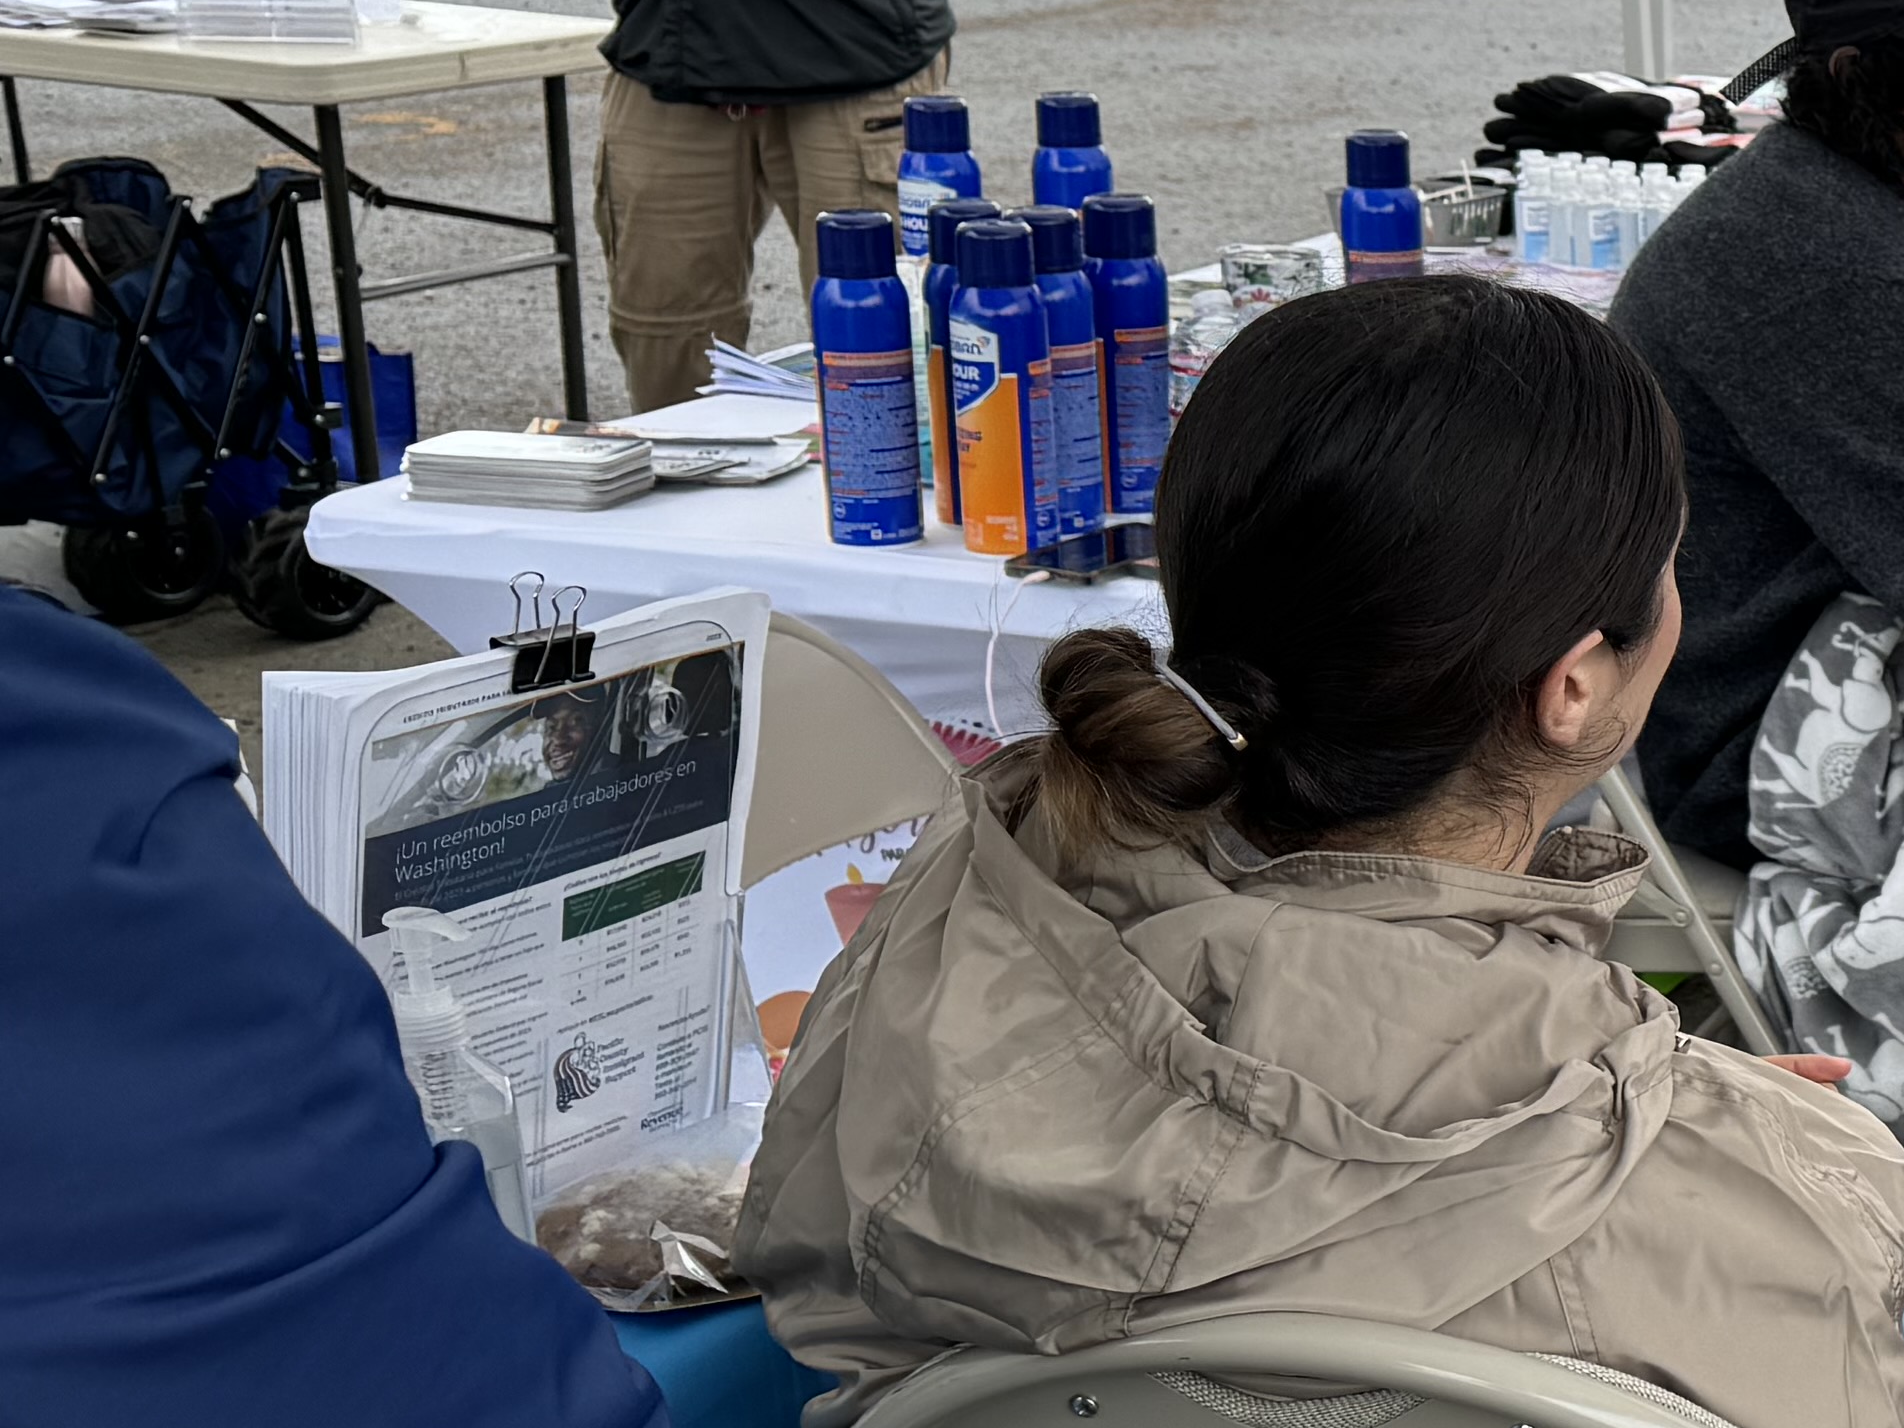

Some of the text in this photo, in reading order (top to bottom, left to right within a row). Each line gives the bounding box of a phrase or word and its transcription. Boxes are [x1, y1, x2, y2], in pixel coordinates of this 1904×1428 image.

[396, 759, 697, 864] ¡Un reembolso para trabajadores en
[394, 839, 506, 885] Washington!
